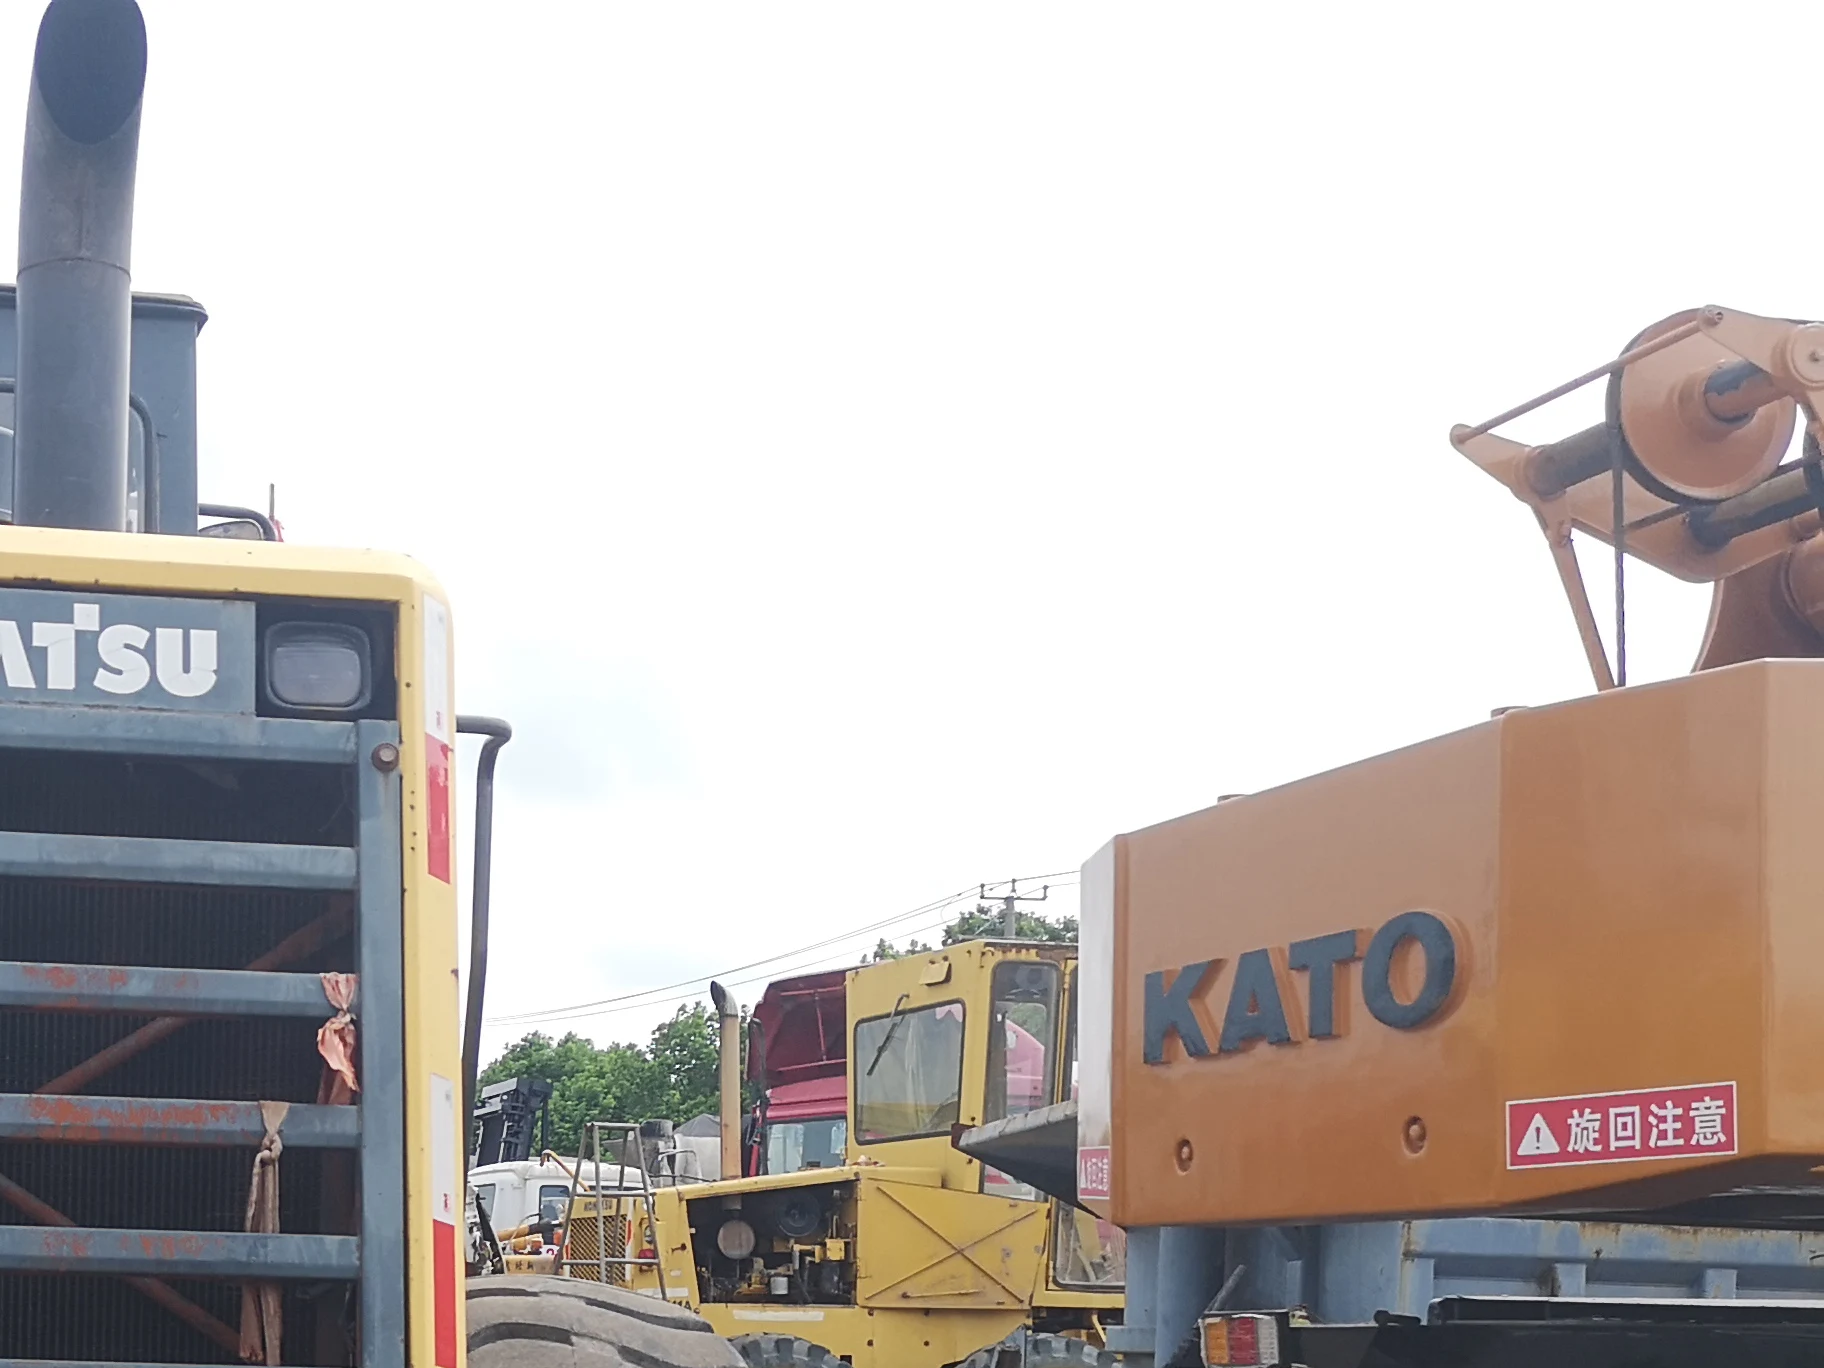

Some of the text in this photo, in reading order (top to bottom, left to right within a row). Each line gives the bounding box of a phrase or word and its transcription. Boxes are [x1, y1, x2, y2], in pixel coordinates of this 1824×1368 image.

[1142, 910, 1460, 1065] KATO
[1566, 1096, 1726, 1154] 旋回注意
